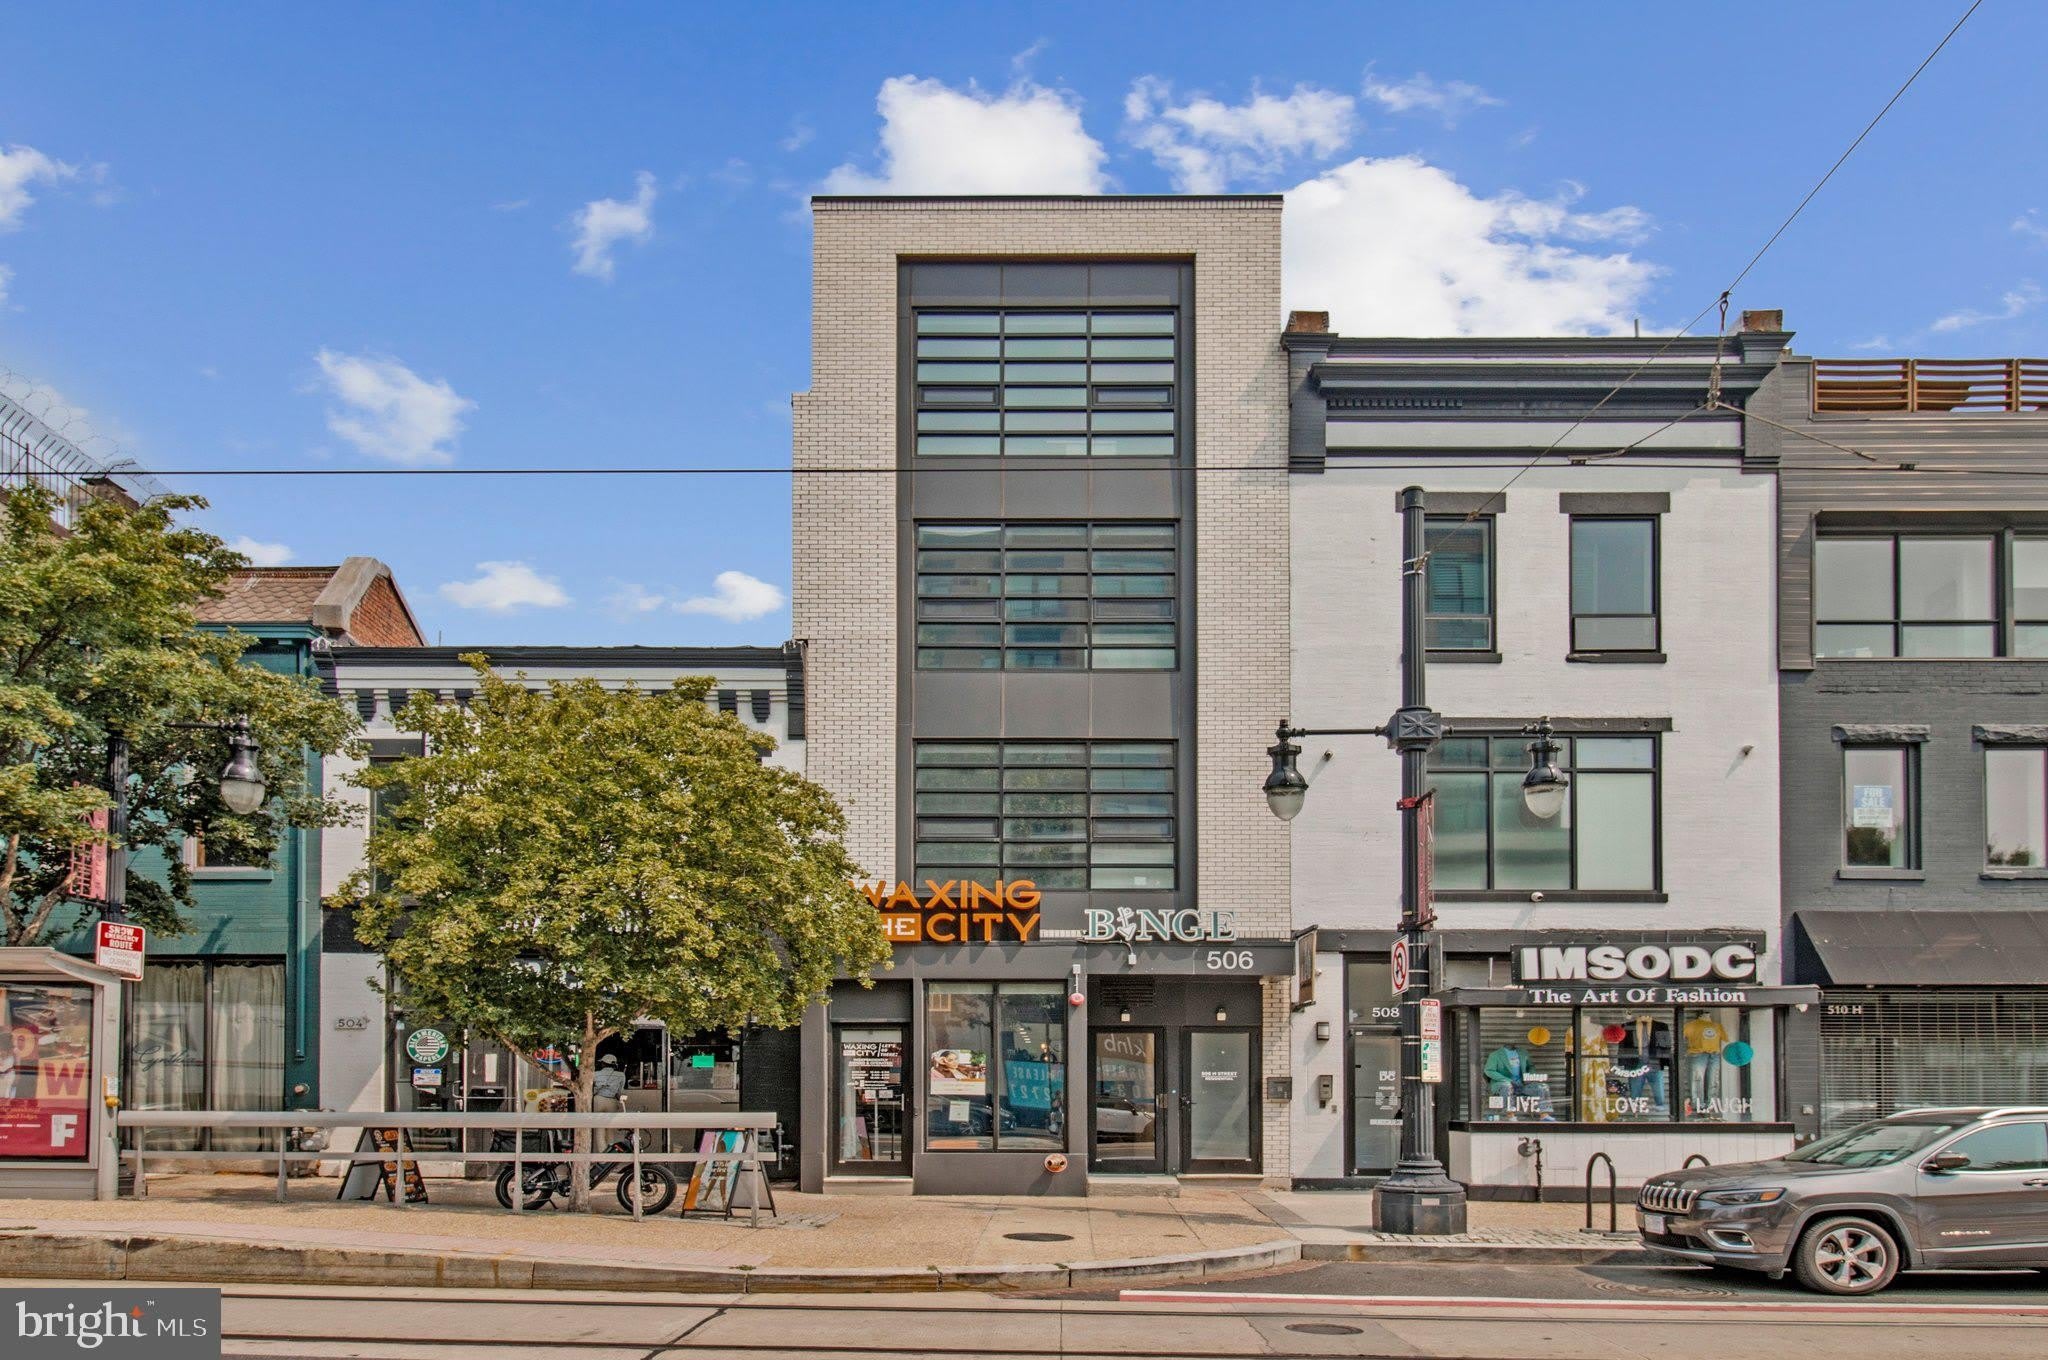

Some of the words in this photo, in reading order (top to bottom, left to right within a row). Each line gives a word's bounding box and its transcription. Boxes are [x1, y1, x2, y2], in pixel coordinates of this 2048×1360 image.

[1864, 788, 1882, 798] FOR
[1861, 798, 1885, 808] SALE
[849, 880, 1041, 910] WAXING
[109, 925, 134, 935] SNOW
[926, 913, 1041, 943] CITY
[105, 932, 139, 942] EMERGENCY
[109, 939, 134, 949] ROUTE
[1206, 951, 1254, 970] 506
[1521, 945, 1755, 980] IMSODC
[1529, 989, 1571, 1003] The
[1580, 989, 1618, 1003] Art
[1626, 988, 1656, 1003] Of
[1665, 988, 1746, 1003] Fashion
[1372, 1007, 1400, 1018] 508
[1828, 1005, 1848, 1015] 510
[1852, 1005, 1862, 1015] H
[338, 1019, 363, 1028] 504
[414, 1053, 441, 1062] PAPERS
[1523, 1073, 1548, 1081] Vintage
[1507, 1096, 1541, 1113] LIVE
[1605, 1097, 1649, 1114] LOVE
[1697, 1098, 1753, 1114] LAUGH
[51, 1114, 78, 1147] F
